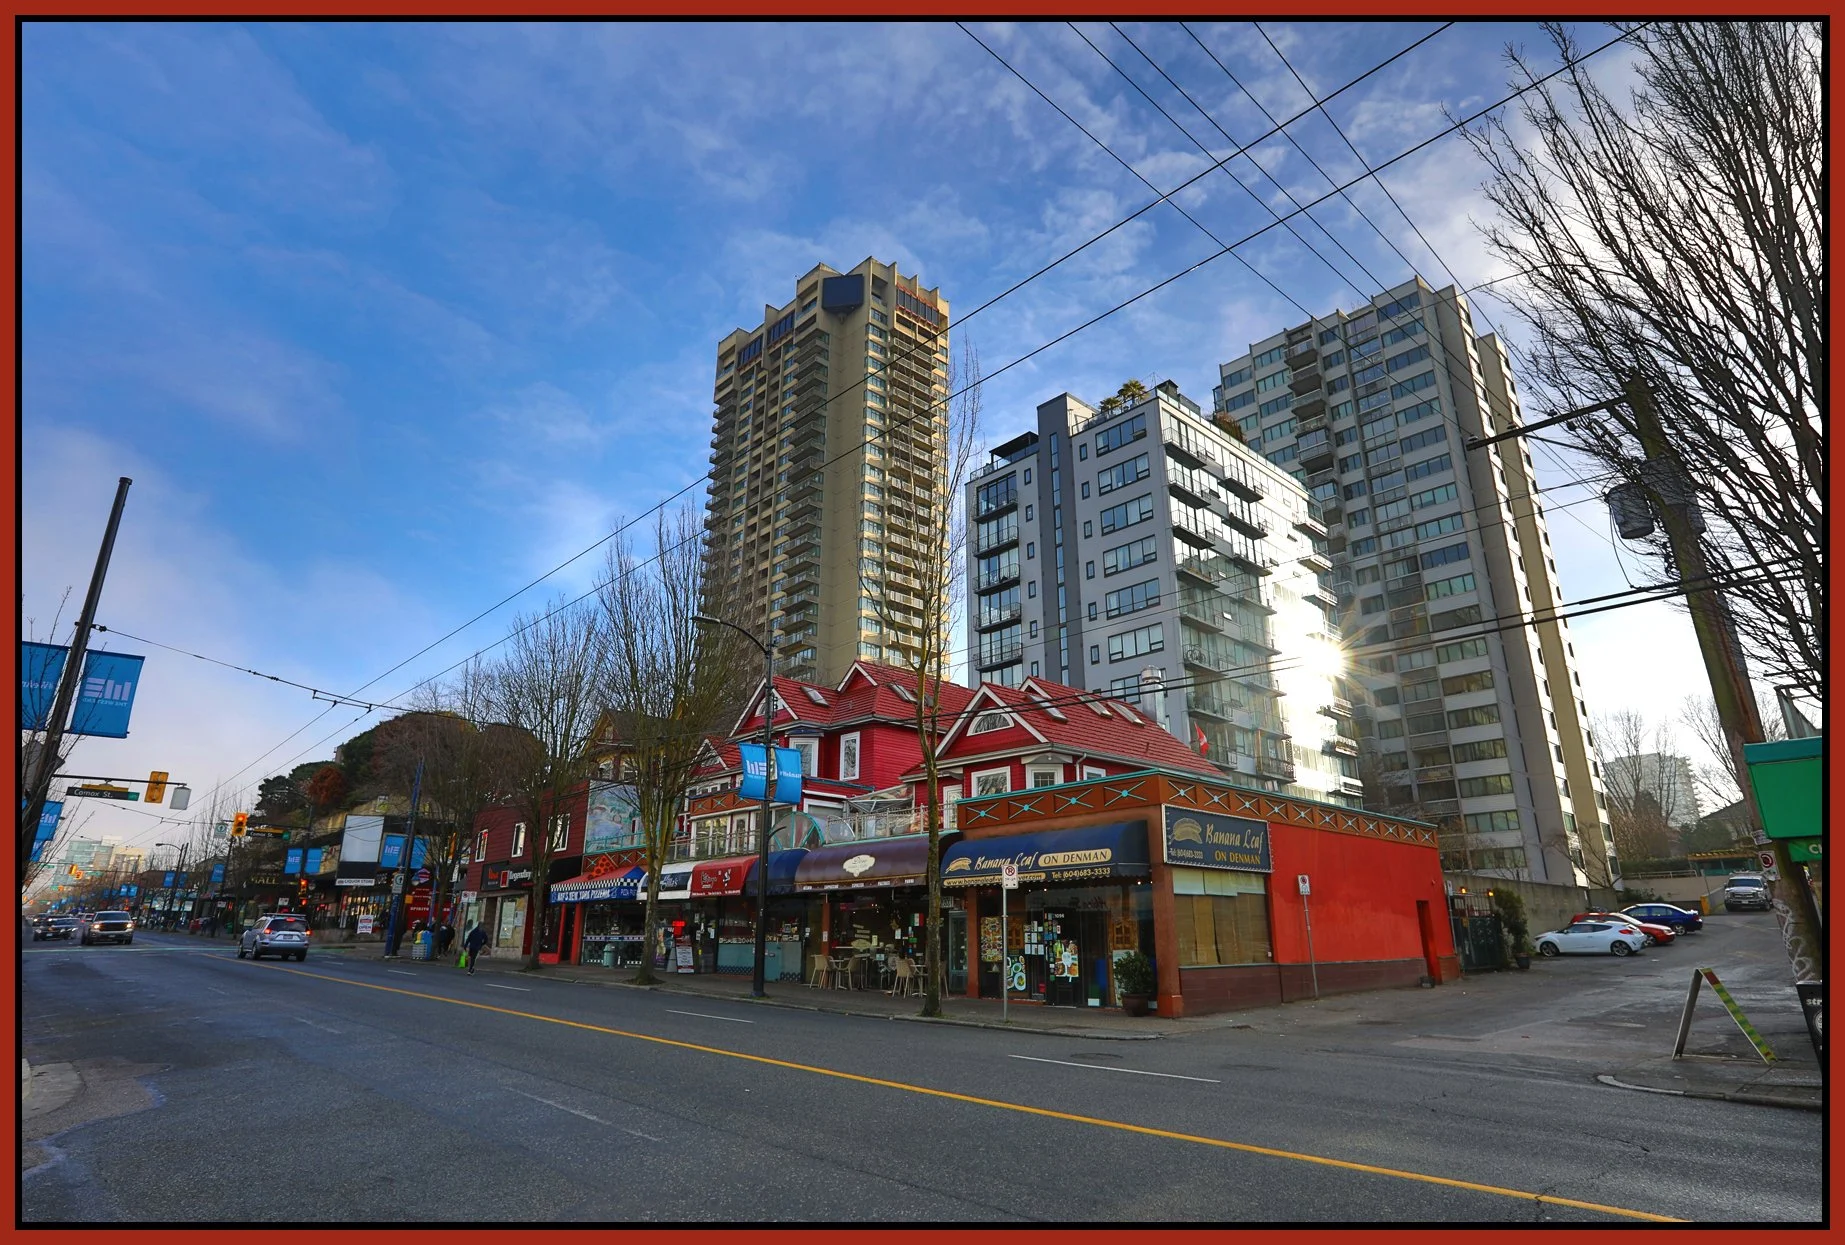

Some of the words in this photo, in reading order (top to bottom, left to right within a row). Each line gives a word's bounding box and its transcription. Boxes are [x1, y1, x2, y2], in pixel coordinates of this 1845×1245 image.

[74, 789, 100, 797] Comox
[1205, 824, 1240, 846] Banana
[1243, 829, 1264, 853] Leaf
[974, 856, 1011, 871] Banana
[1014, 852, 1039, 870] Leaf
[1043, 855, 1059, 864] ON
[1063, 851, 1108, 863] DENMAN
[1215, 850, 1227, 861] ON
[1230, 852, 1261, 865] DENMAN
[1052, 871, 1062, 879] Tel:
